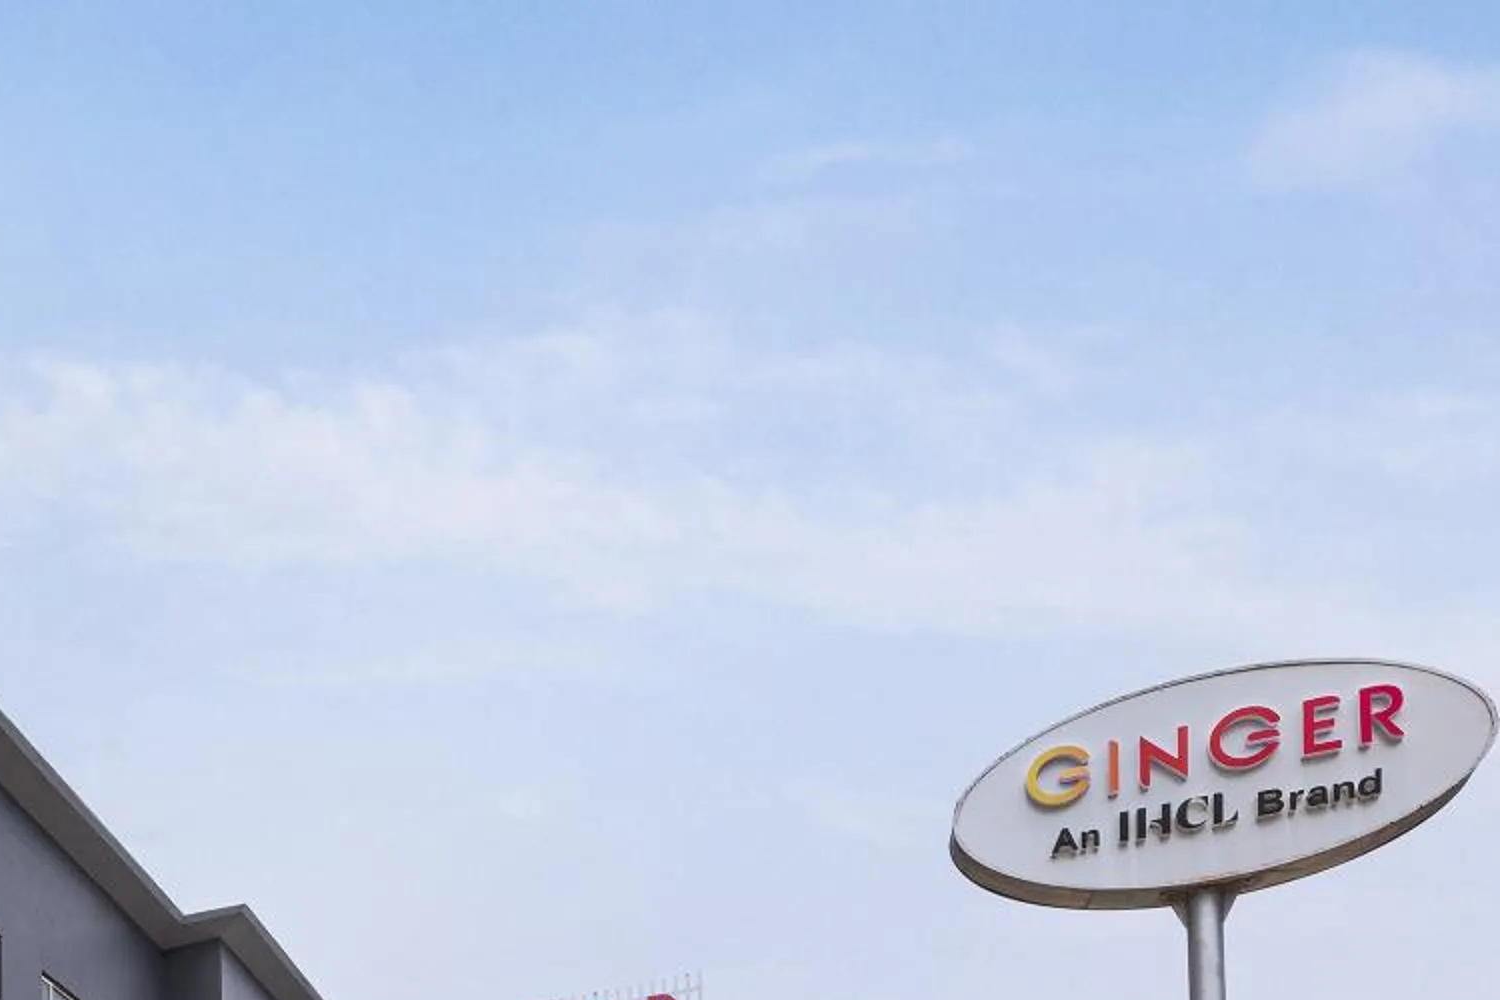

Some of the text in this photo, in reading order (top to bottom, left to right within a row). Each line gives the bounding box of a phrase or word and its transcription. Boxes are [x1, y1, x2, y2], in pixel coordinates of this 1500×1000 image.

[1025, 683, 1405, 808] GINGER
[1051, 768, 1383, 858] An IHCL Brand
